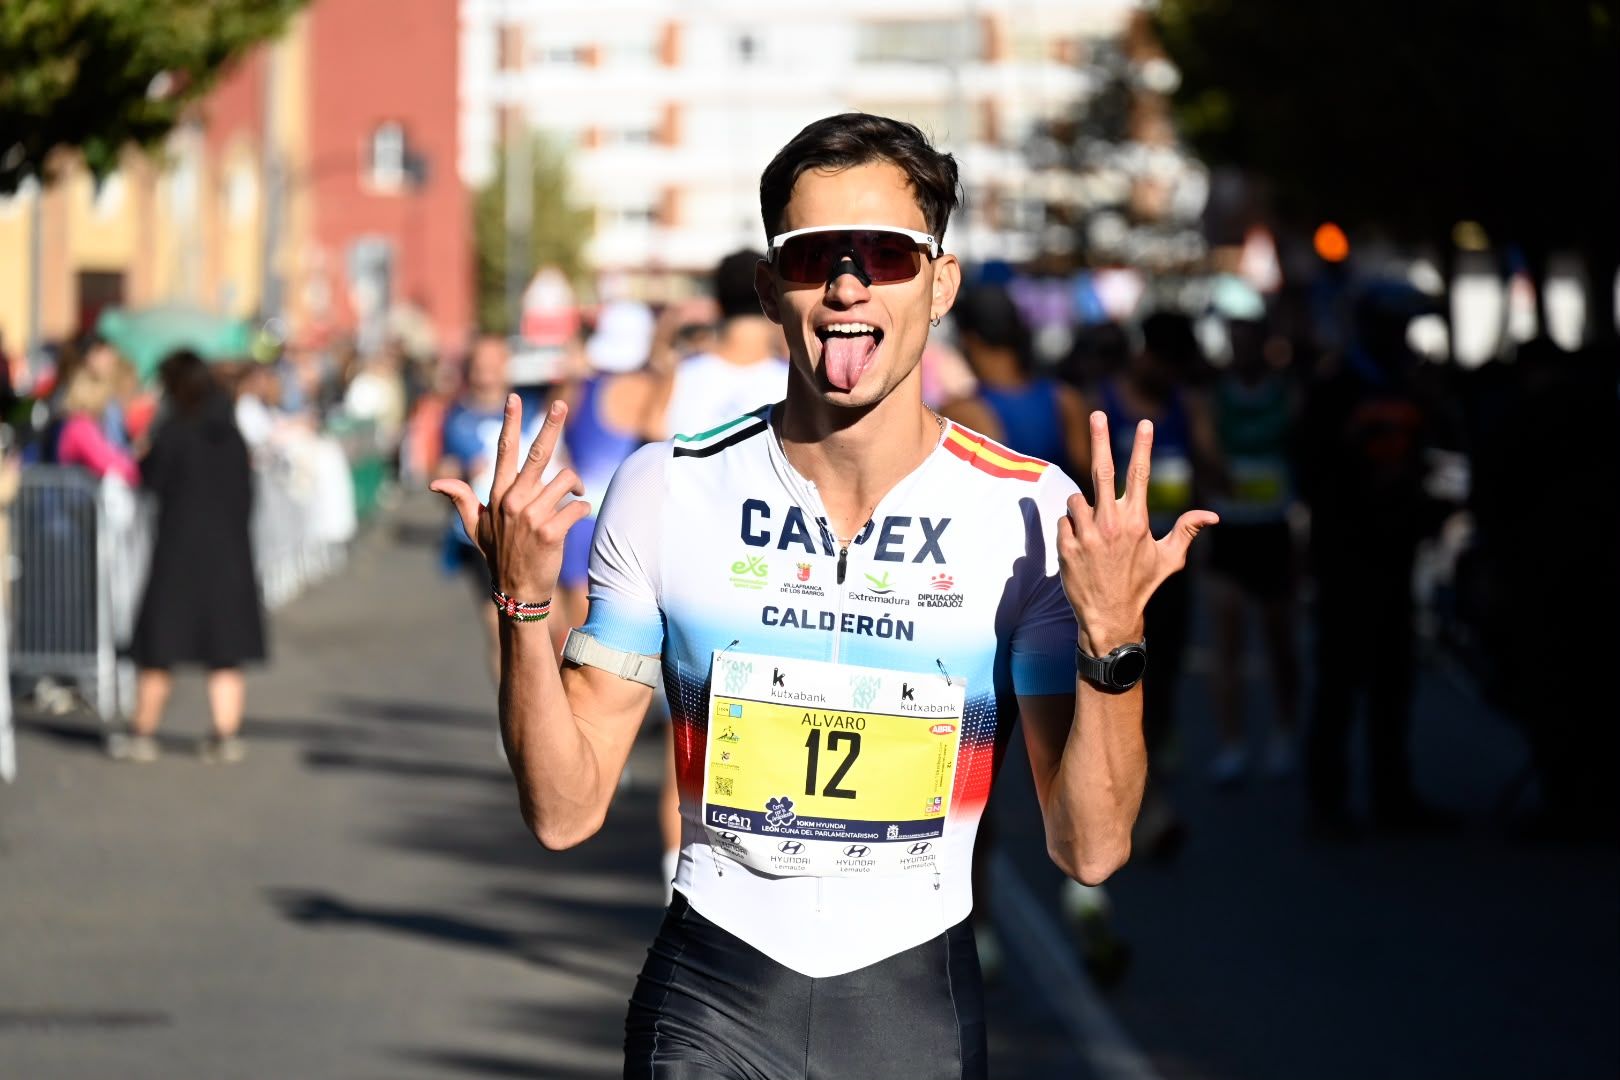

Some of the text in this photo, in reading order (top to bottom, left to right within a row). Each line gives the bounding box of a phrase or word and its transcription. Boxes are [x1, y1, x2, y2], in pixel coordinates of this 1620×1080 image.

[783, 582, 822, 591] VILLAFRANCA
[801, 589, 825, 597] BARROS
[917, 593, 964, 601] DIPUTACIÓN
[848, 591, 910, 606] Extremadura
[926, 600, 963, 608] BADAJOZ
[762, 605, 914, 641] CALDERÓN
[771, 688, 826, 702] kutxabank
[900, 702, 956, 712] kutxabank
[801, 713, 866, 730] ALVARO
[805, 728, 861, 799] 12
[780, 827, 800, 835] CUNA
[814, 830, 879, 839] PARLAMENTARISMO
[770, 855, 811, 864] HYUNDAI
[899, 854, 936, 864] HYUNDAI
